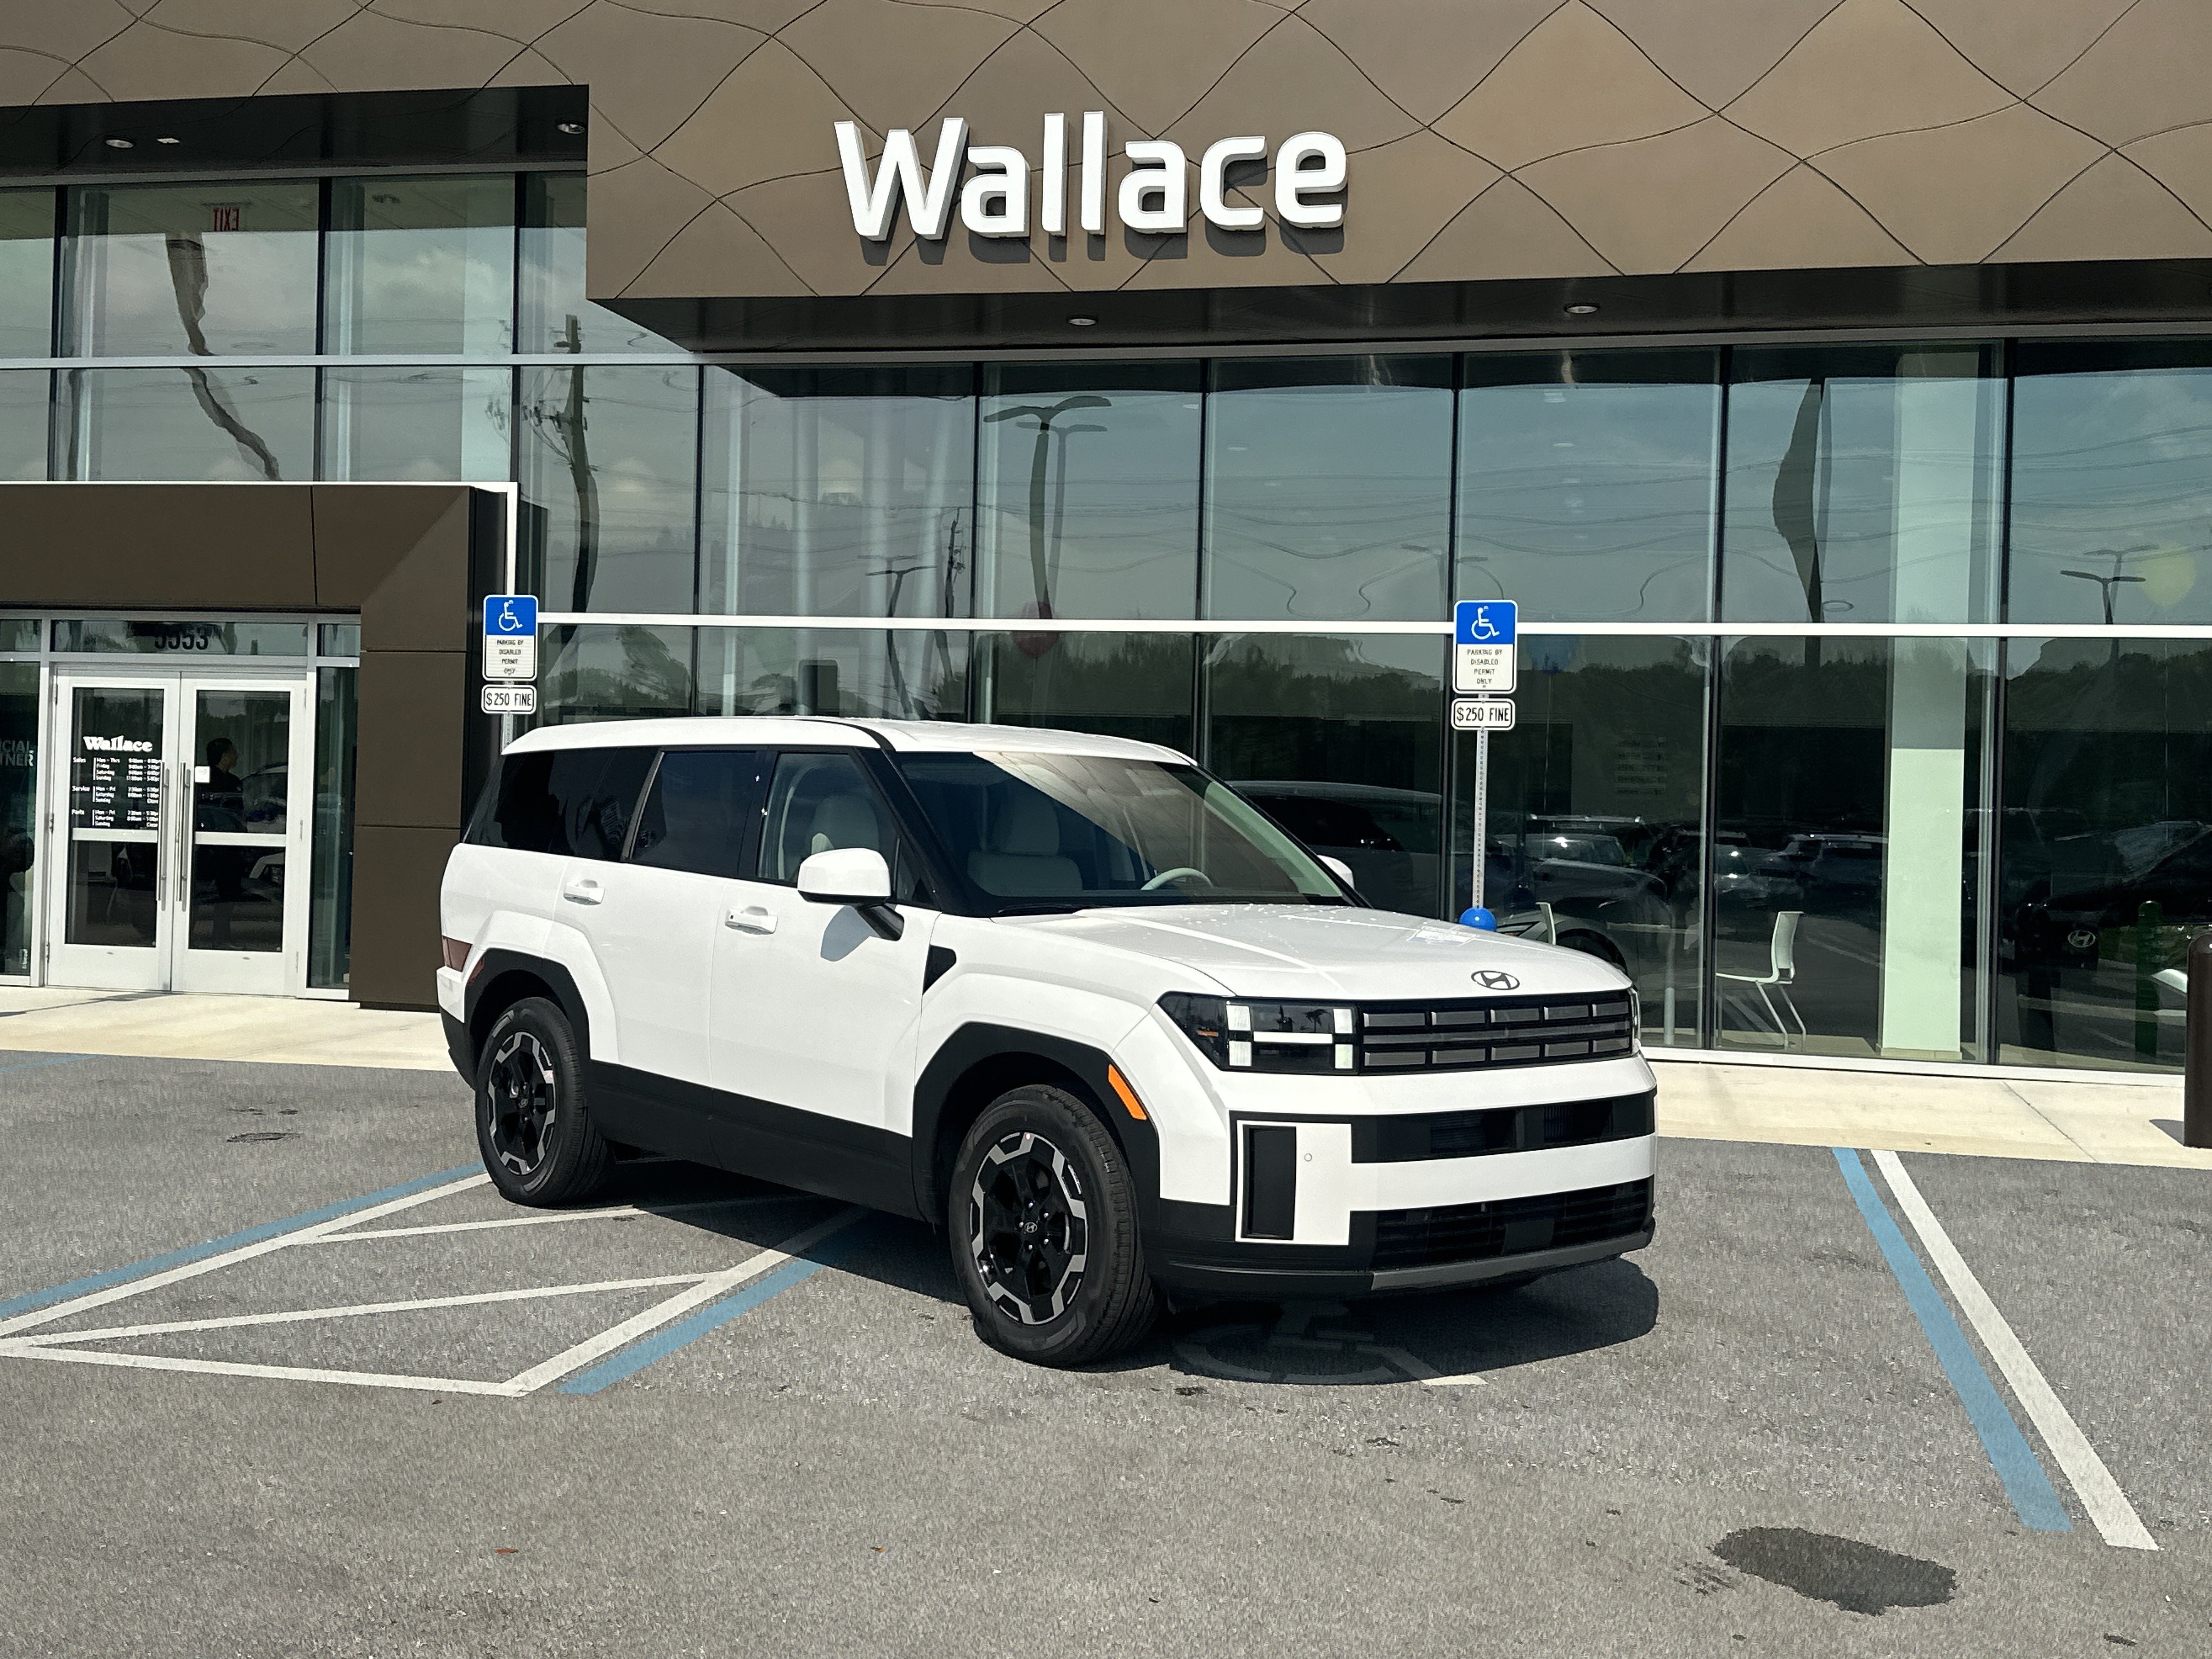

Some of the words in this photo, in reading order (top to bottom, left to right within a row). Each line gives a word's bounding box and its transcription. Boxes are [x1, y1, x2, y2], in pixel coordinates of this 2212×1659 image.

[833, 110, 1347, 241] Wallace
[486, 692, 510, 707] $250
[514, 693, 532, 706] FINE
[1457, 707, 1484, 722] $250
[1489, 707, 1509, 721] FINE
[83, 735, 153, 752] Wallace
